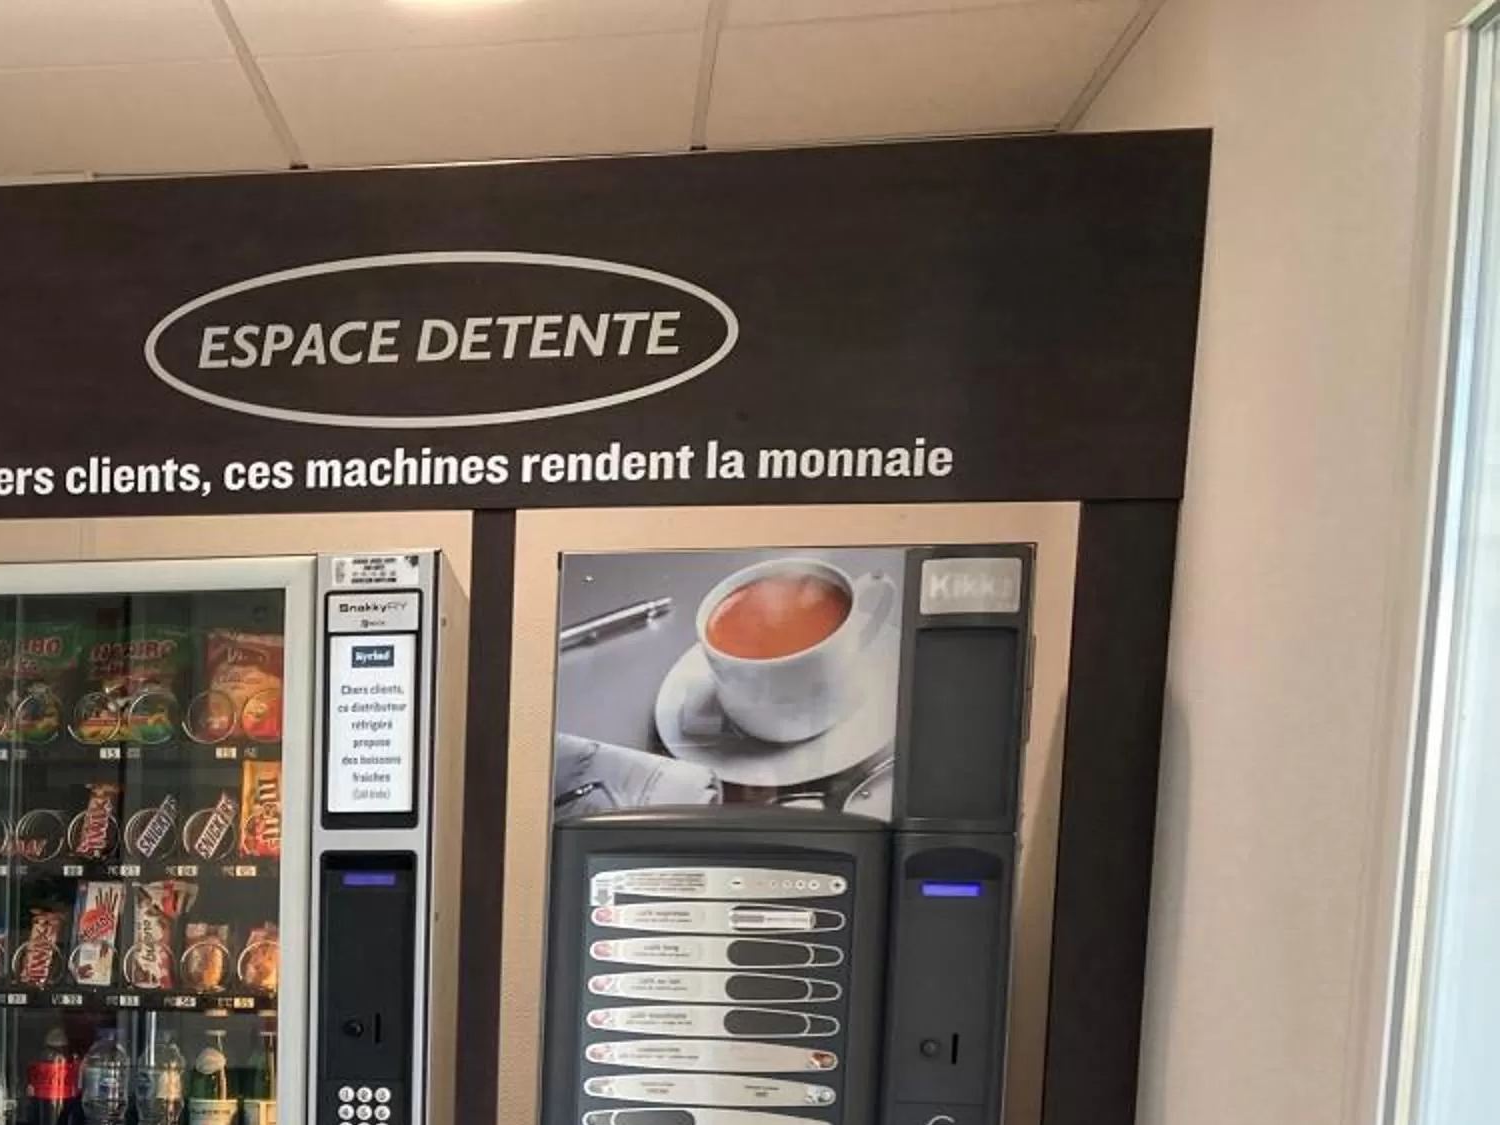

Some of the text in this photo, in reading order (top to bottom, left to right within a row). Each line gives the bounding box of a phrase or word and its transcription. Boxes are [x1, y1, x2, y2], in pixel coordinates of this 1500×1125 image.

[198, 311, 681, 369] ESPACE DETENTE
[65, 456, 212, 497] clients,
[223, 459, 294, 491] ces
[306, 447, 509, 488] machines
[521, 442, 695, 484] rendent
[706, 439, 746, 480] la
[758, 437, 954, 480] monnaie
